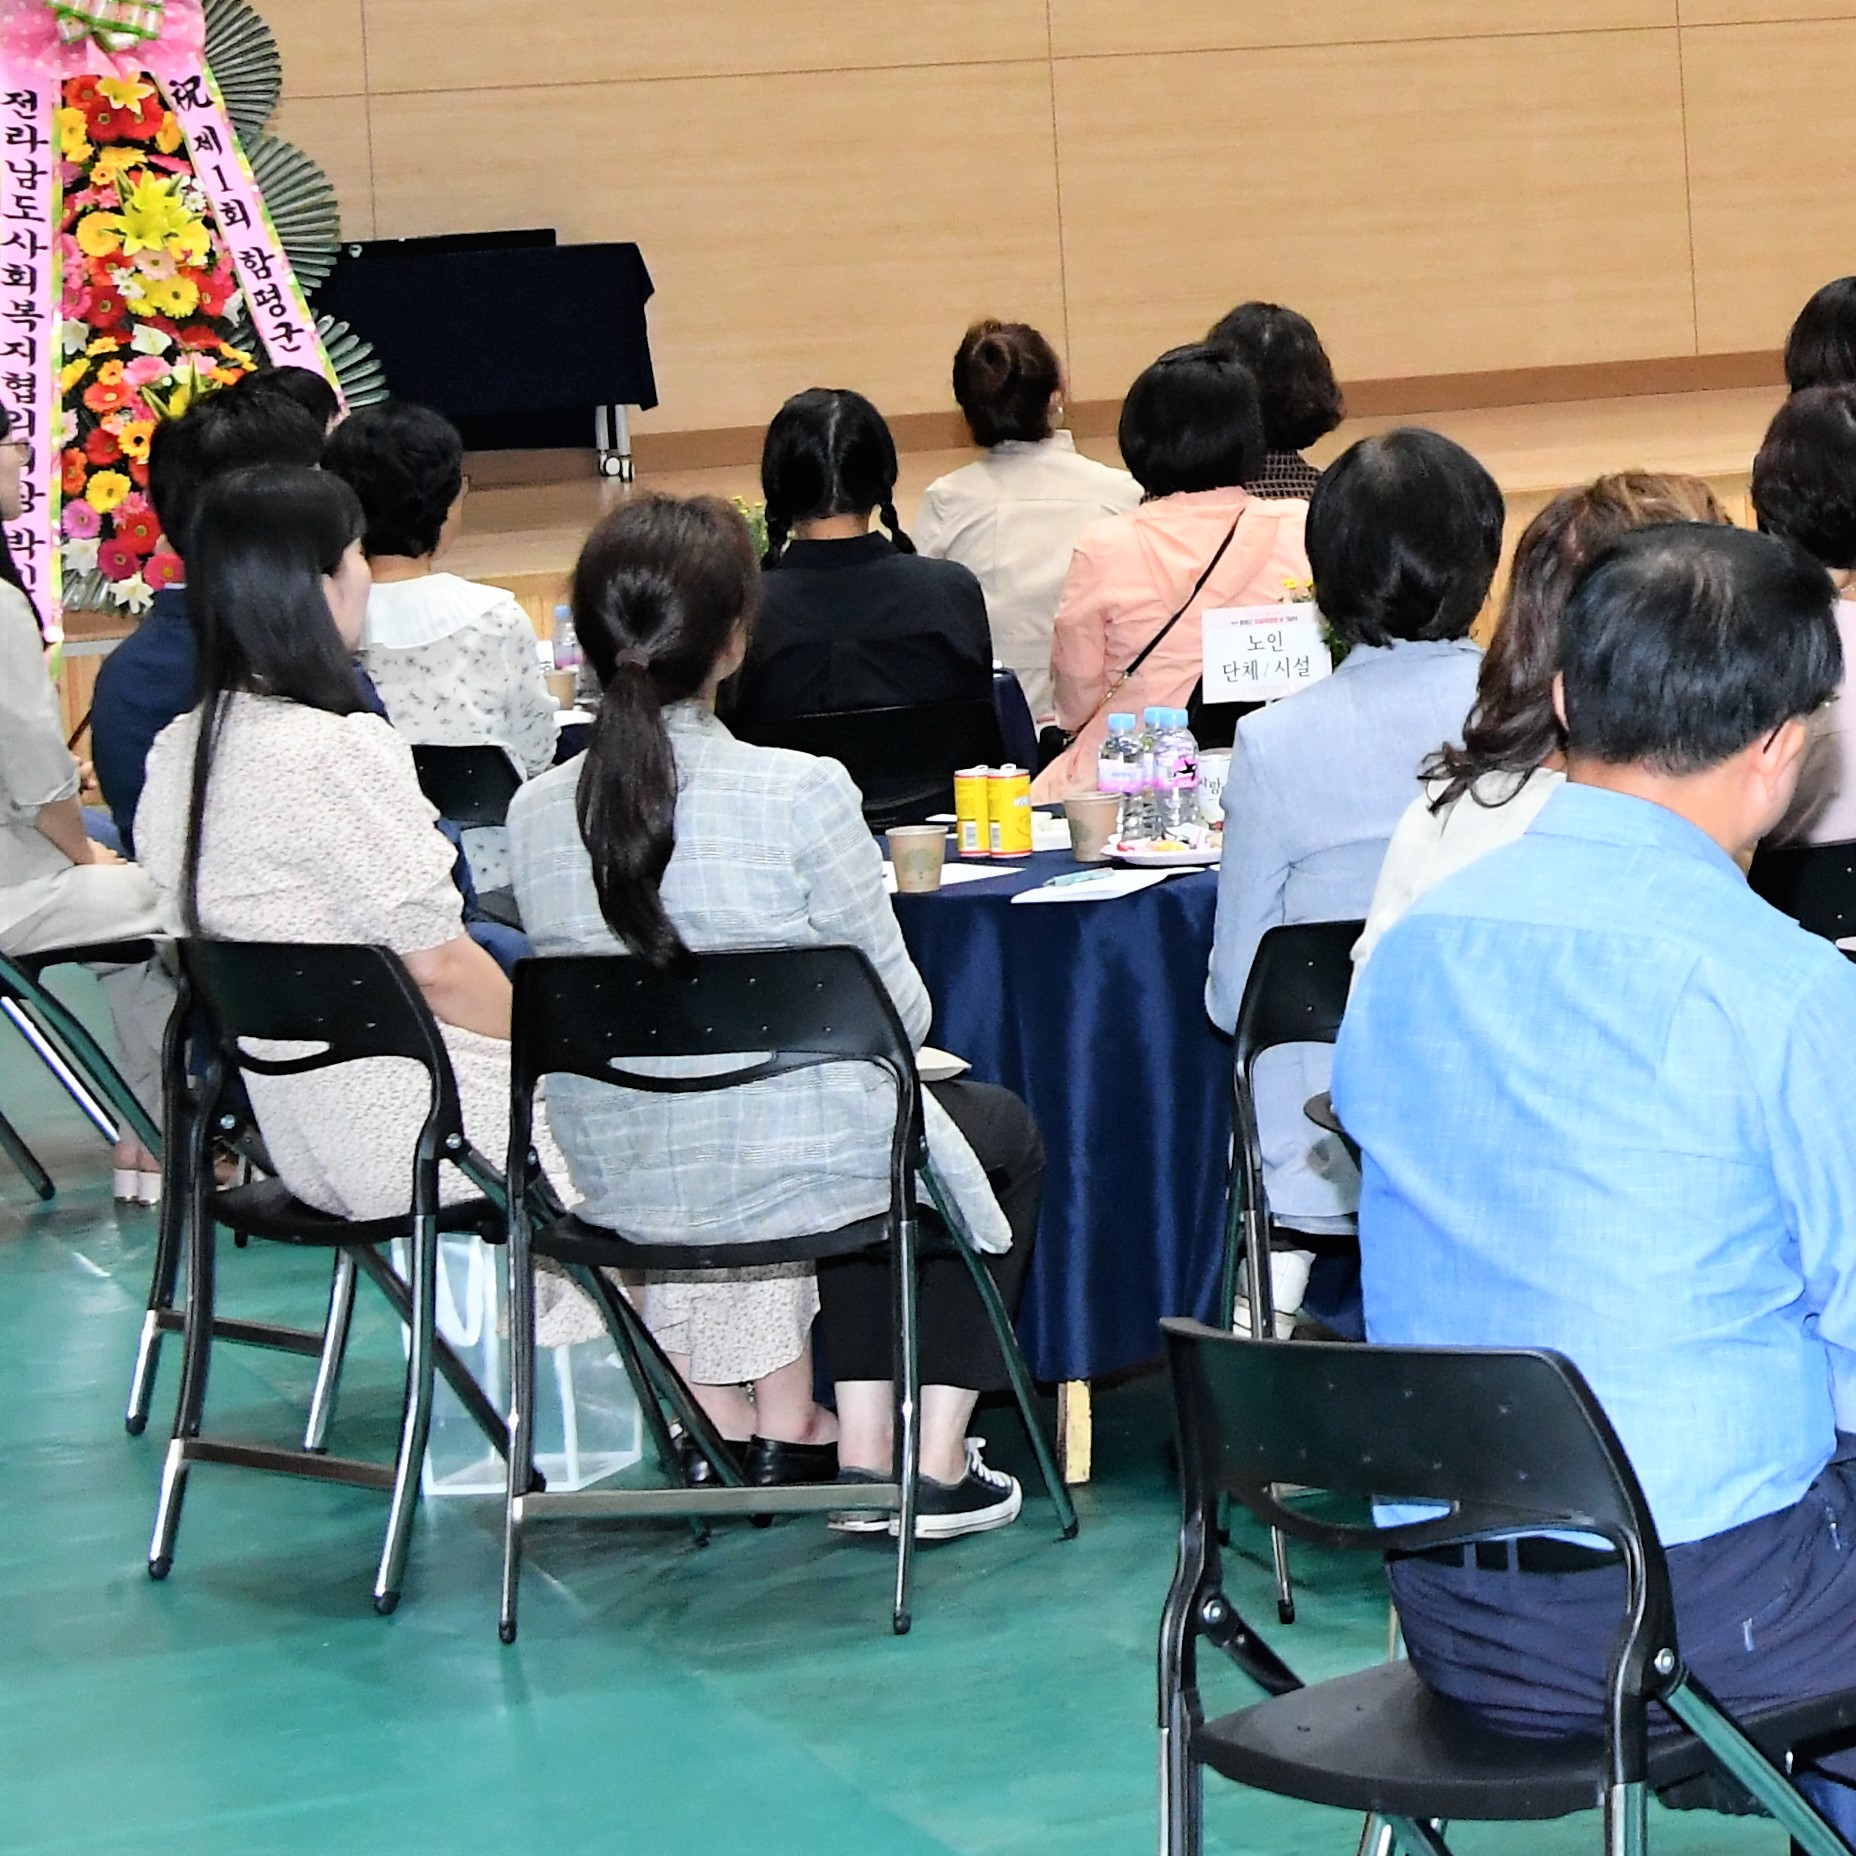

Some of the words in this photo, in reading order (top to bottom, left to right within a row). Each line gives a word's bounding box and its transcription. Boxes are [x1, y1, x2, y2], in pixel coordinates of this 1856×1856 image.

[170, 75, 215, 110] 祝
[193, 125, 251, 230] 제1회
[239, 247, 305, 352] 함평군
[1247, 630, 1284, 653] 노인
